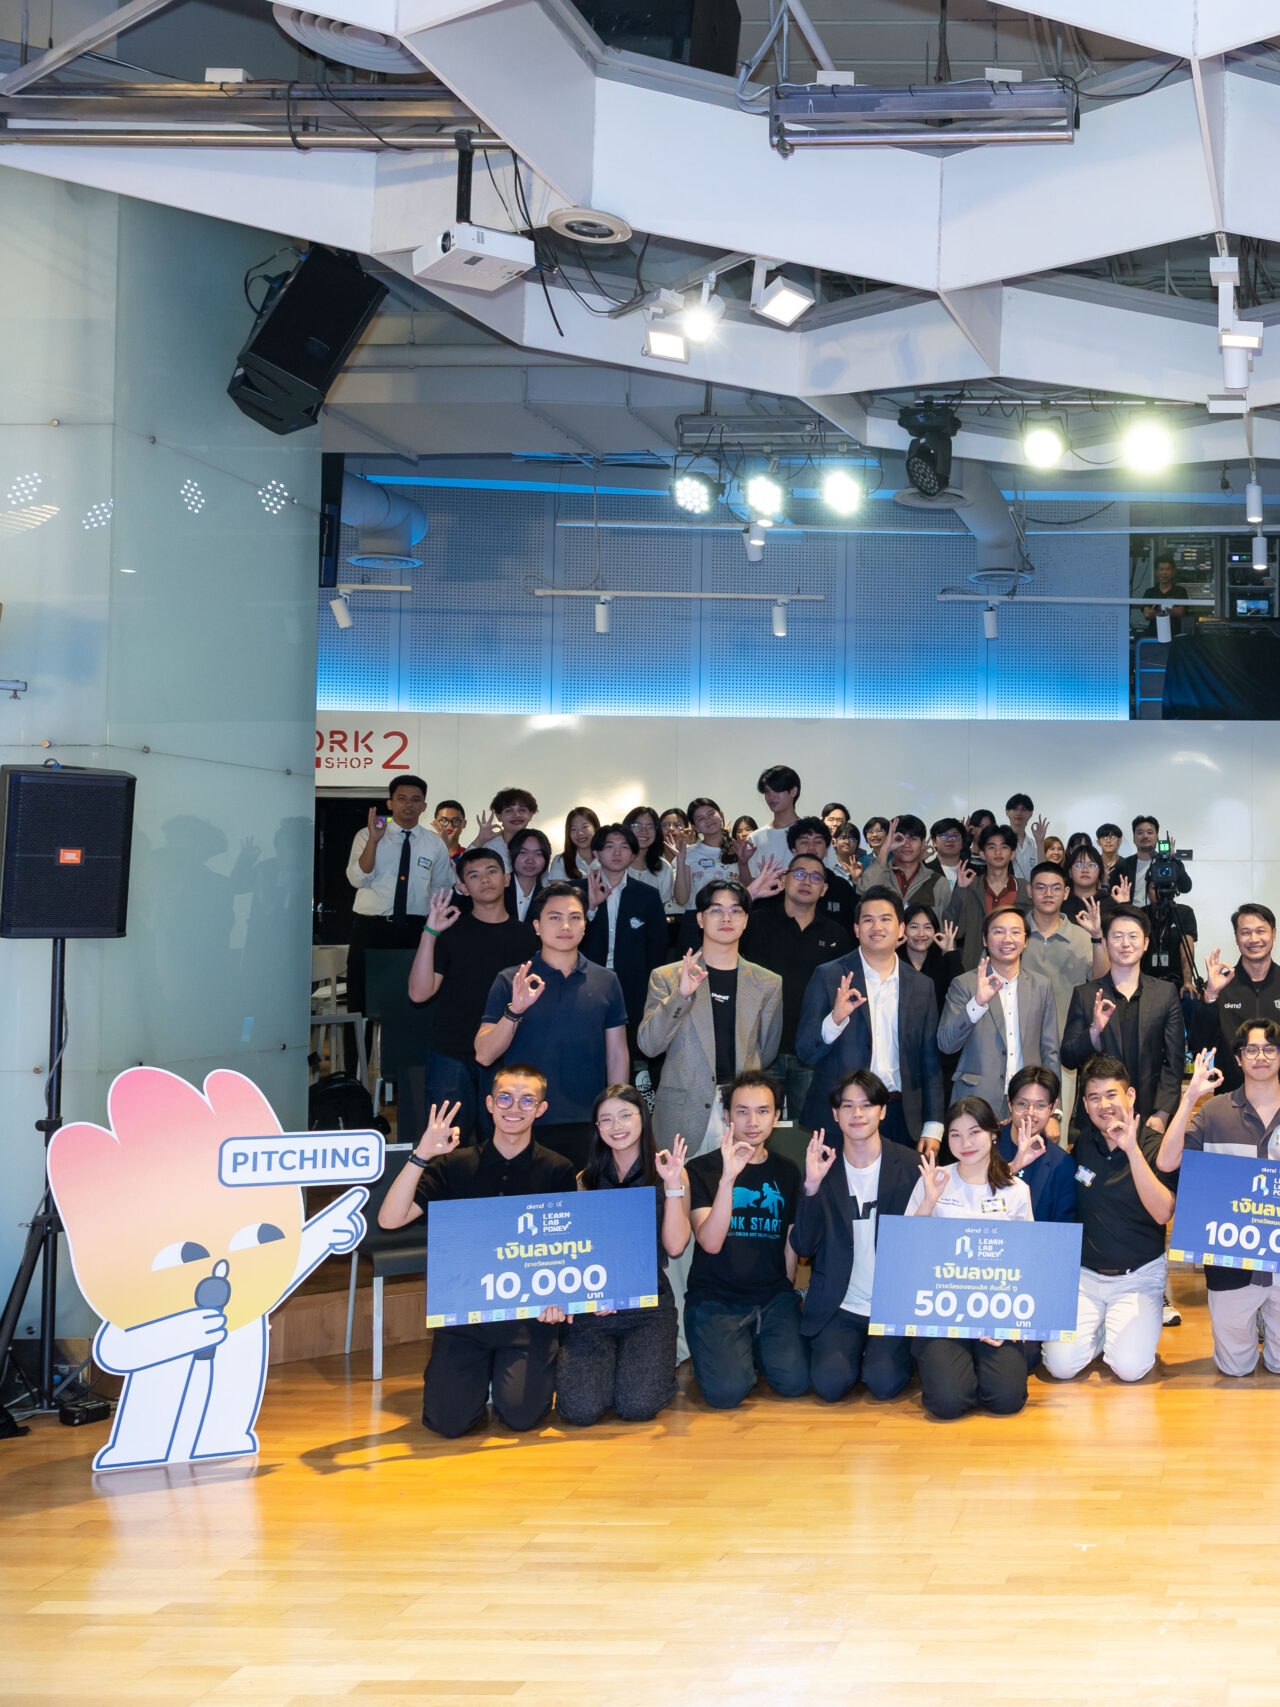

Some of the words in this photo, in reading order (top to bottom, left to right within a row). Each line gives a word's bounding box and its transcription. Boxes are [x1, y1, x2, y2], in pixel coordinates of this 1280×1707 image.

[315, 730, 374, 753] RK
[381, 730, 410, 770] 2
[325, 756, 374, 769] SHOP
[232, 1146, 370, 1173] PITCHING
[750, 1216, 782, 1232] START
[497, 1239, 591, 1260] เงินลงทุน
[480, 1264, 608, 1303] 10,000
[935, 1262, 1020, 1285] เงินลงทุน
[587, 1291, 604, 1300] บาท
[914, 1289, 1035, 1323] 50,000
[1016, 1320, 1032, 1328] บาท
